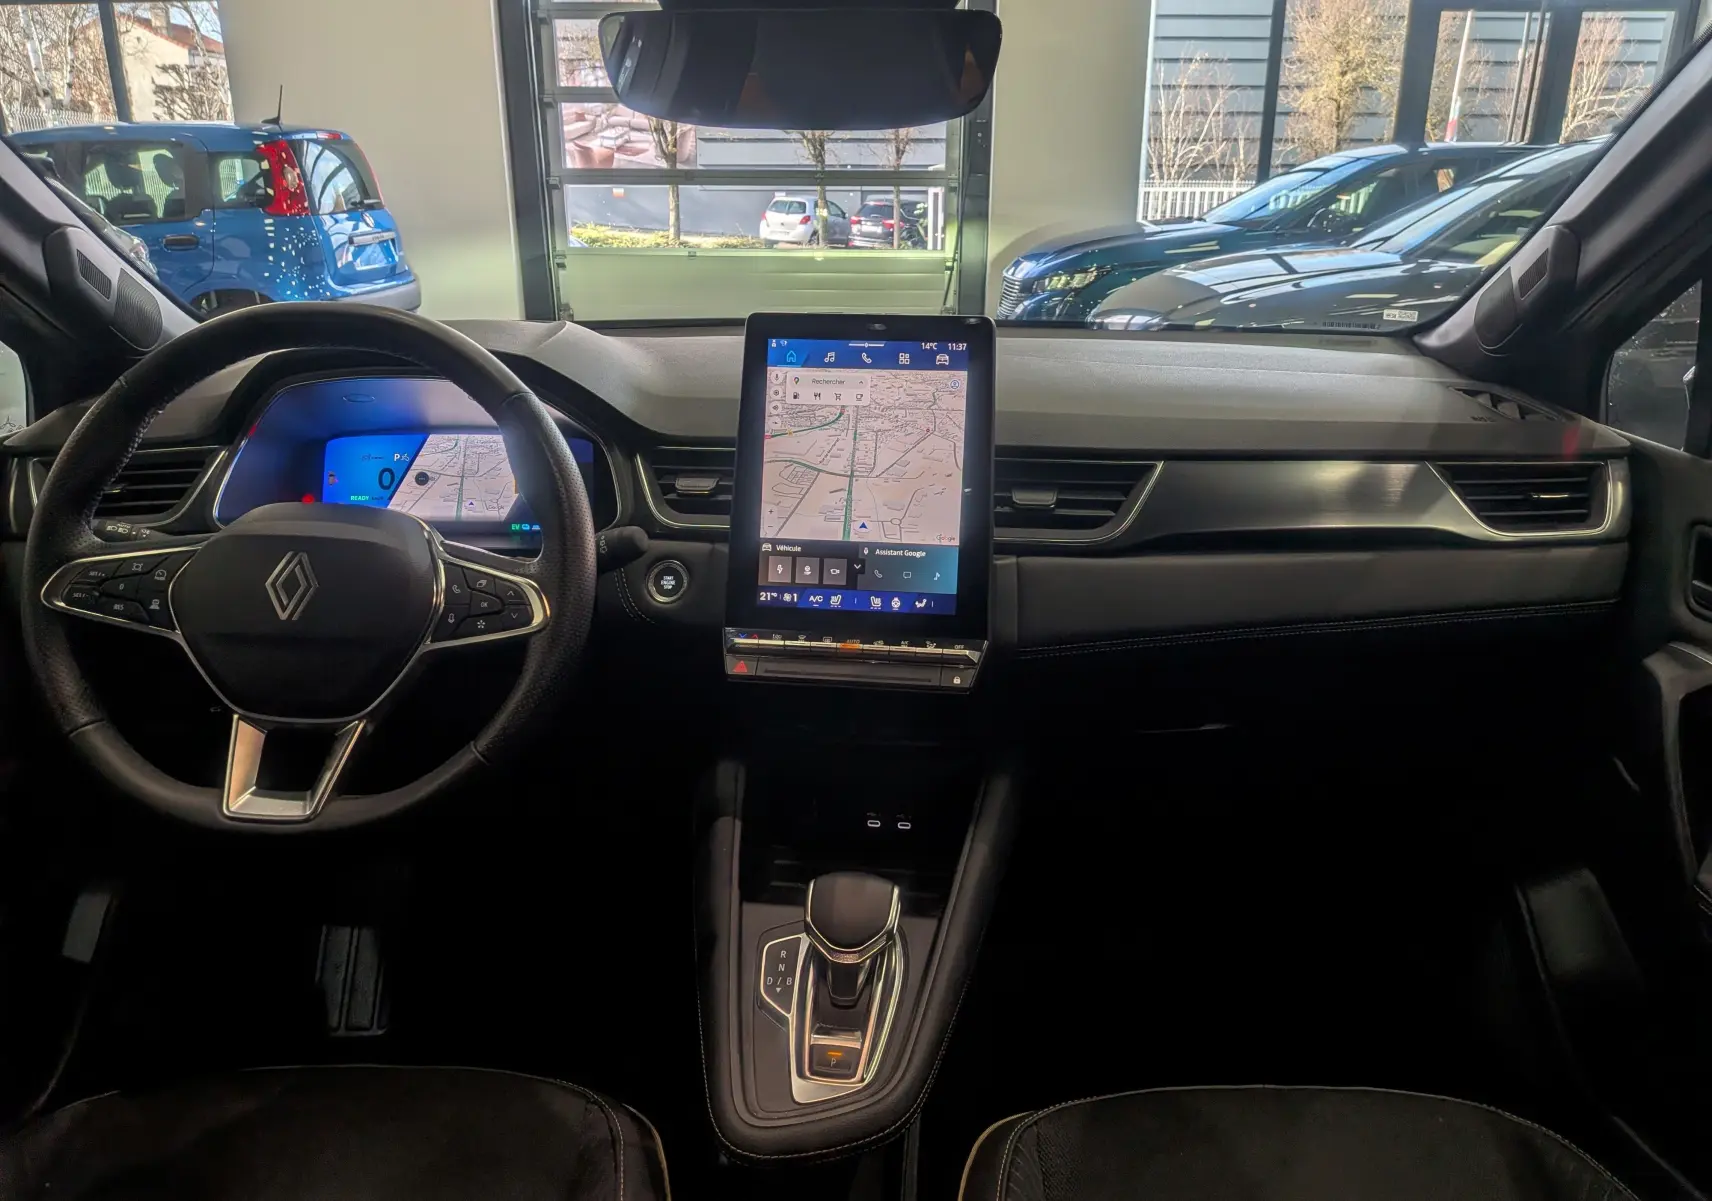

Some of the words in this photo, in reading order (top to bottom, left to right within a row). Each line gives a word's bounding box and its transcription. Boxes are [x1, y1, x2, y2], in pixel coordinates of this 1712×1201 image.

[947, 343, 967, 351] 11:37
[812, 378, 846, 386] Rechercher
[394, 454, 400, 462] P
[378, 468, 395, 490] 0
[875, 548, 903, 556] Assistant
[904, 549, 927, 557] Google
[780, 950, 787, 960] R
[778, 963, 786, 972] N
[831, 1058, 836, 1067] P
